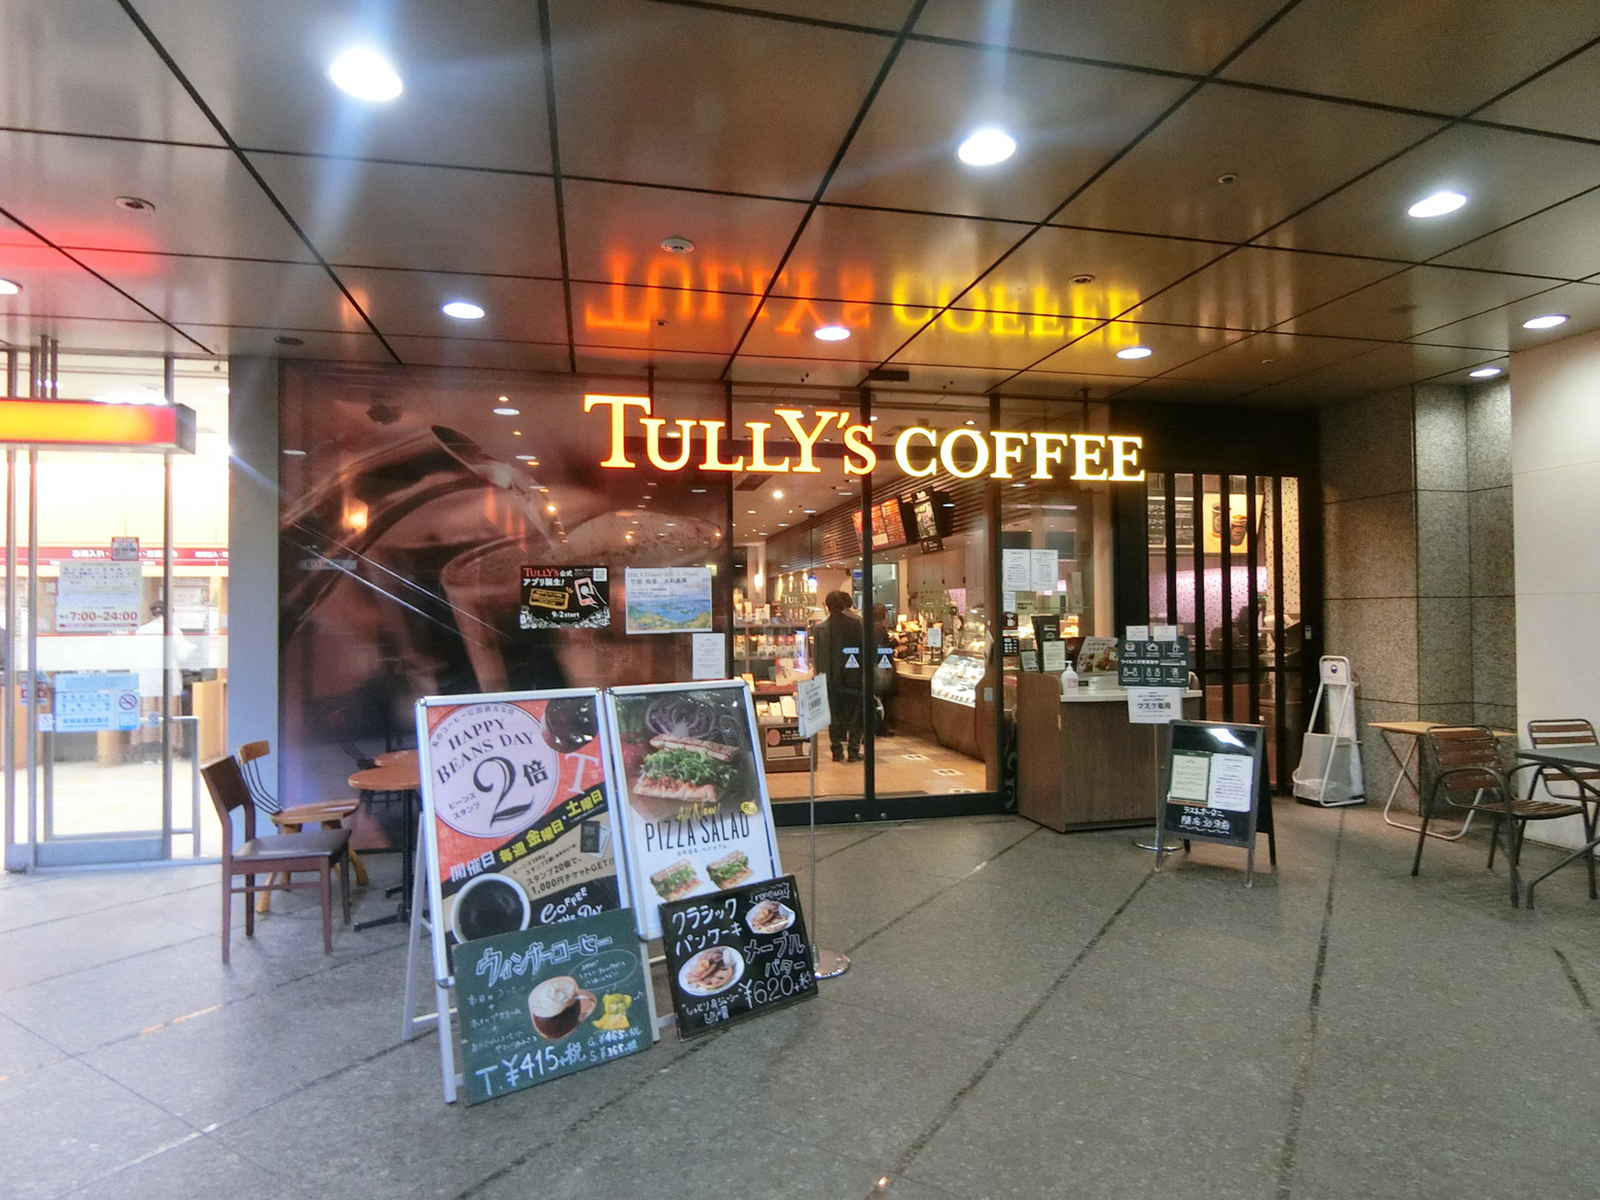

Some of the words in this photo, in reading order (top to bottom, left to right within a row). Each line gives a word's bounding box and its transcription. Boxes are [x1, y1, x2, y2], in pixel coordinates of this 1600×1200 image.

[583, 394, 878, 476] TULLY'S
[894, 426, 1146, 482] COFFEE
[448, 718, 505, 750] HAPPY
[437, 738, 494, 784] BEANS
[499, 731, 533, 748] DAY
[645, 816, 697, 852] PIZZA
[700, 811, 750, 844] SALAD
[450, 851, 496, 882] 開催日
[499, 841, 528, 863] 毎週
[673, 898, 737, 935] クラシック
[676, 921, 743, 956] パンケーキ
[744, 930, 805, 964] メープル
[765, 958, 805, 977] バター
